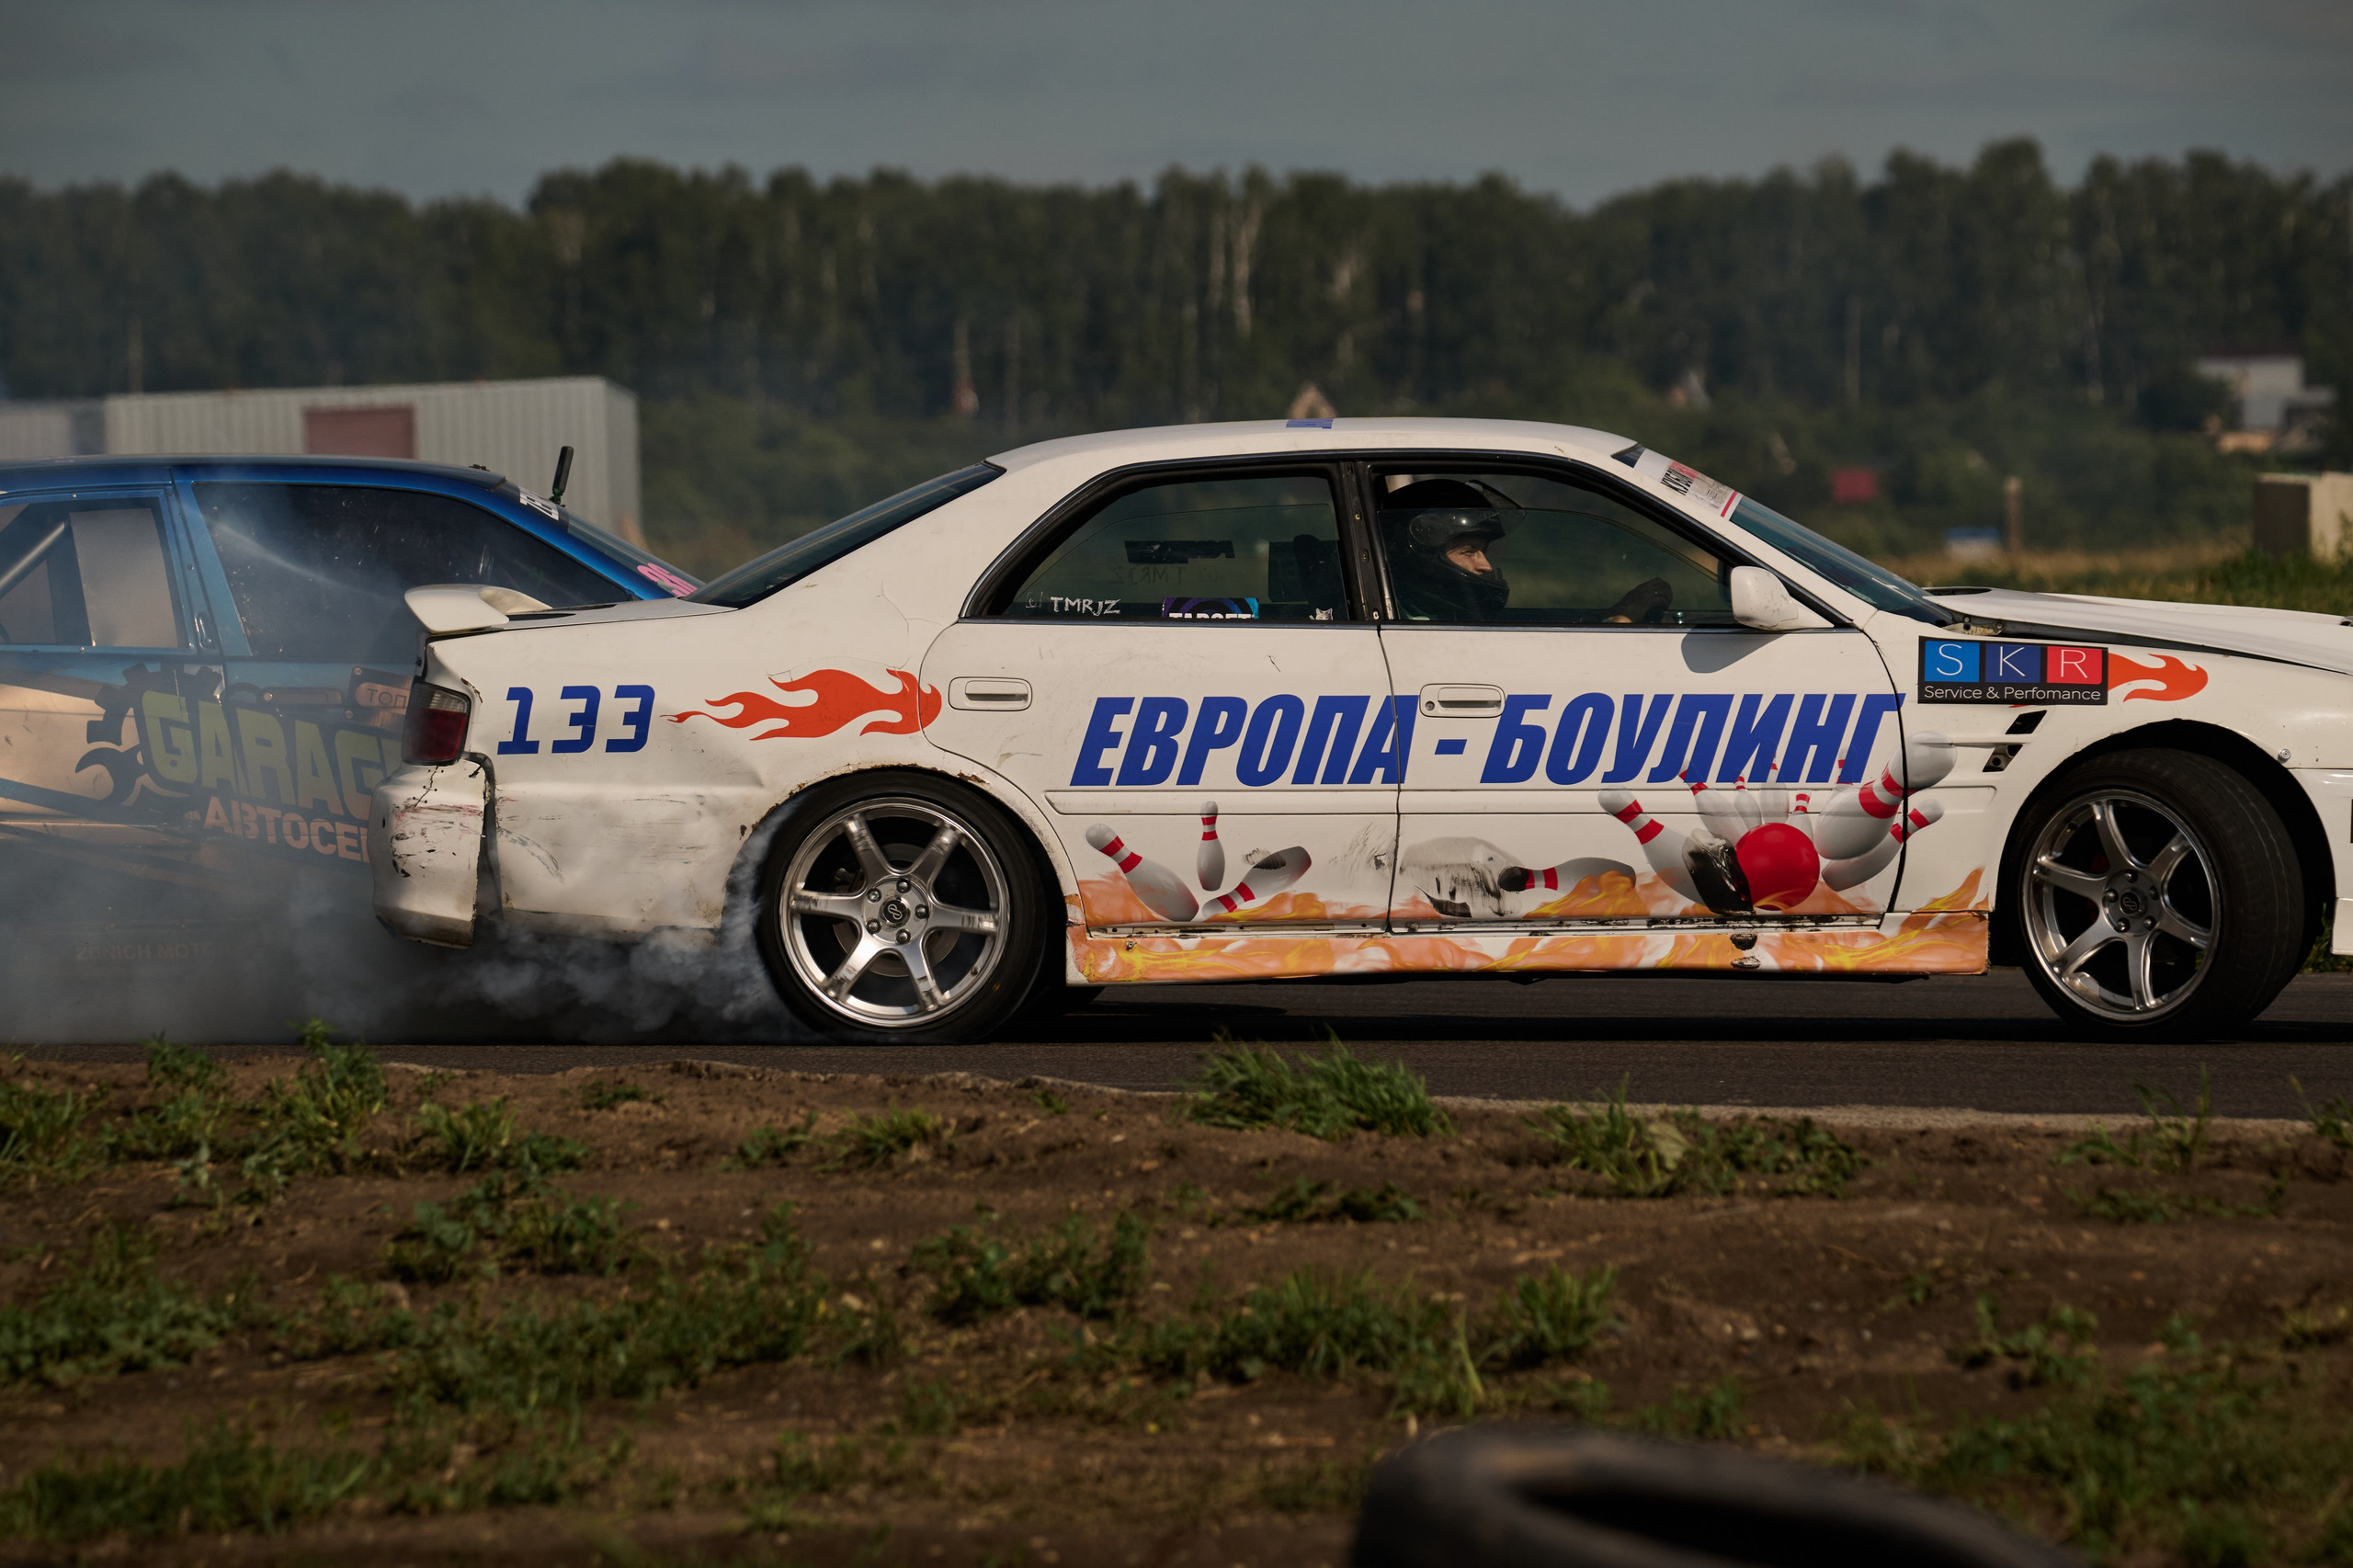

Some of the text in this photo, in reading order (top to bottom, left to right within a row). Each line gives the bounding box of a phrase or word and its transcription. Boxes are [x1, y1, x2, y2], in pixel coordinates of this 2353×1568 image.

[1936, 643, 2088, 678] SKR
[1924, 685, 2101, 700] Service & Perfomance
[497, 685, 655, 755] 133
[1070, 694, 1419, 787] ЕВРОПА
[1480, 692, 1906, 786] БОУЛИНГ
